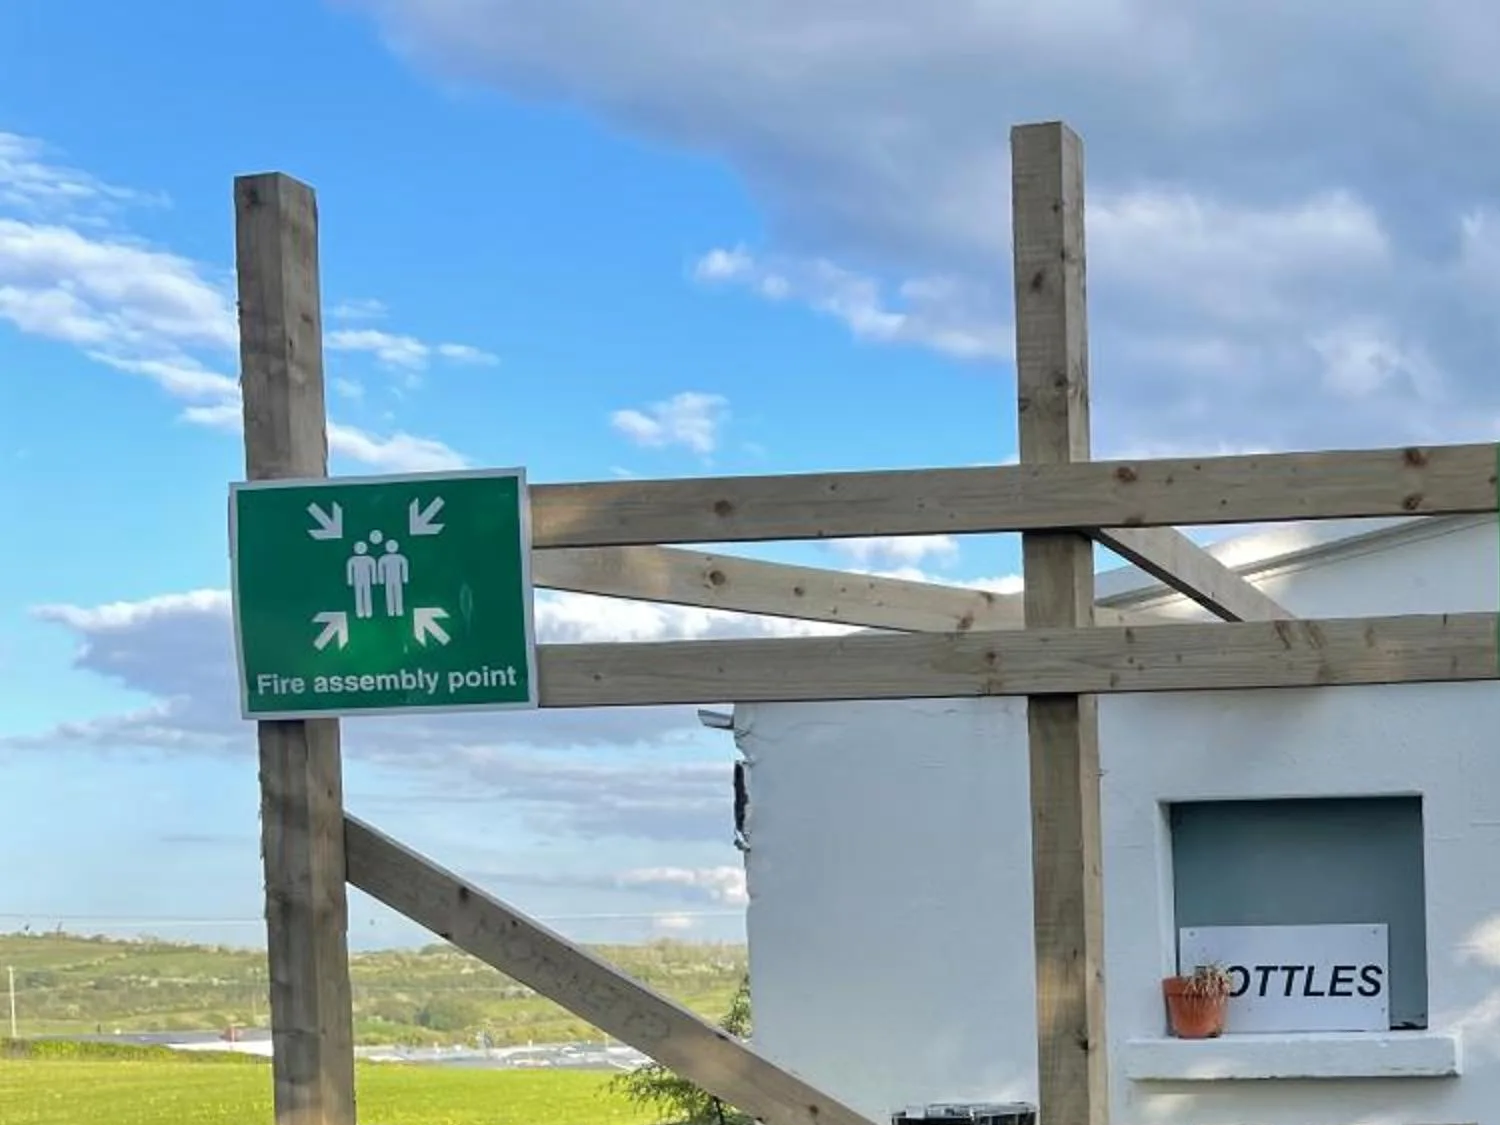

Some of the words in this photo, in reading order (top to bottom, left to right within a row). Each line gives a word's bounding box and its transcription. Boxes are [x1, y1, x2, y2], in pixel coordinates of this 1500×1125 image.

[257, 673, 305, 695] Fire
[313, 669, 438, 694] assembly
[447, 667, 516, 691] point
[1195, 965, 1383, 997] OTTLES
